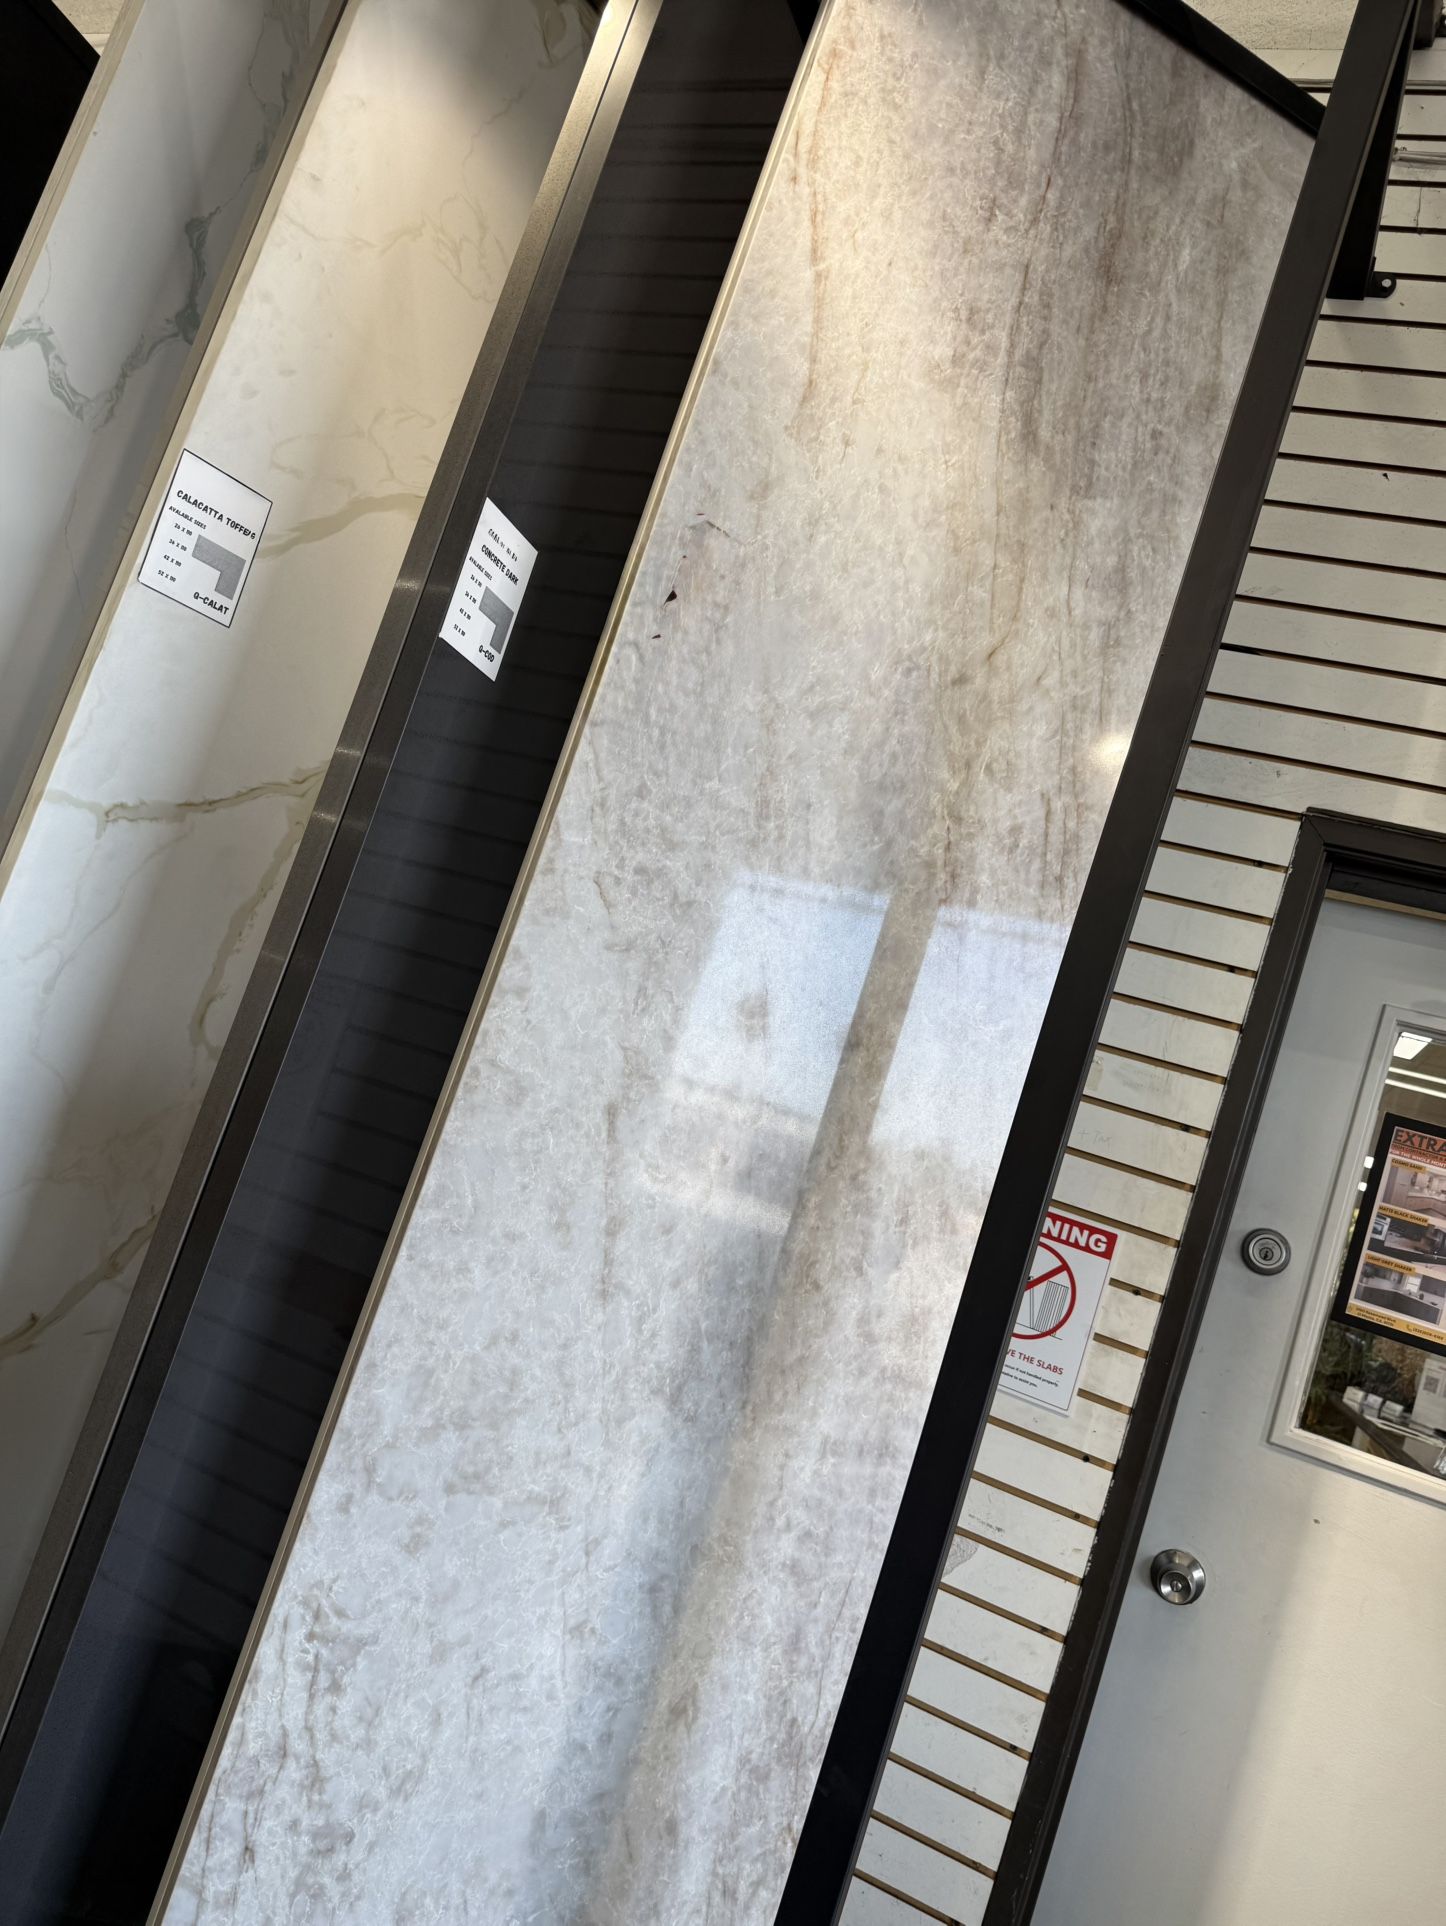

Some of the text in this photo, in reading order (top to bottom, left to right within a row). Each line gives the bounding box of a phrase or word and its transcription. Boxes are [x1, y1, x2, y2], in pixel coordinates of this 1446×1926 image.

[177, 489, 224, 522] CALACATTA
[481, 544, 507, 575] CONCRETE
[505, 568, 519, 586] DARK
[193, 591, 230, 616] Q-CALAT
[1409, 1213, 1429, 1224] SHAKER
[1018, 1352, 1035, 1364] THE
[1036, 1359, 1063, 1375] SLABS
